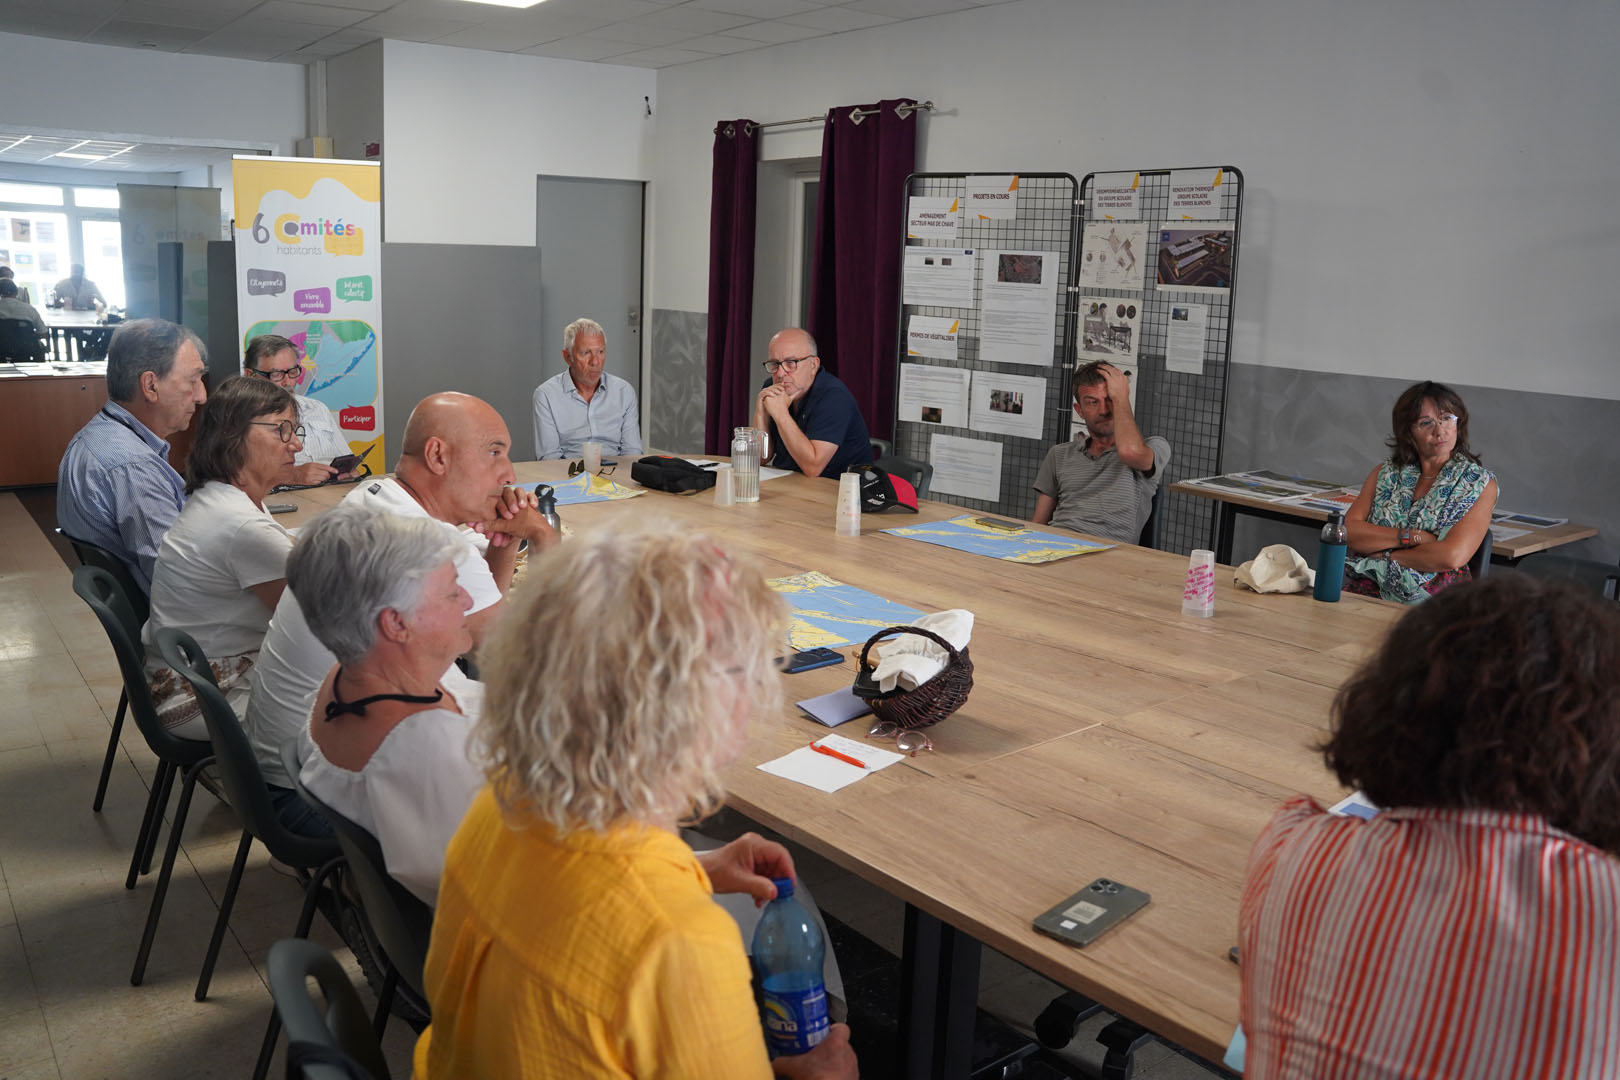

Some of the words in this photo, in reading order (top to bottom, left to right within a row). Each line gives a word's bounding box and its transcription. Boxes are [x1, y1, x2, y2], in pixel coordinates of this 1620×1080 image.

[252, 212, 270, 244] 6
[276, 245, 323, 256] habitants
[344, 415, 372, 424] Participer
